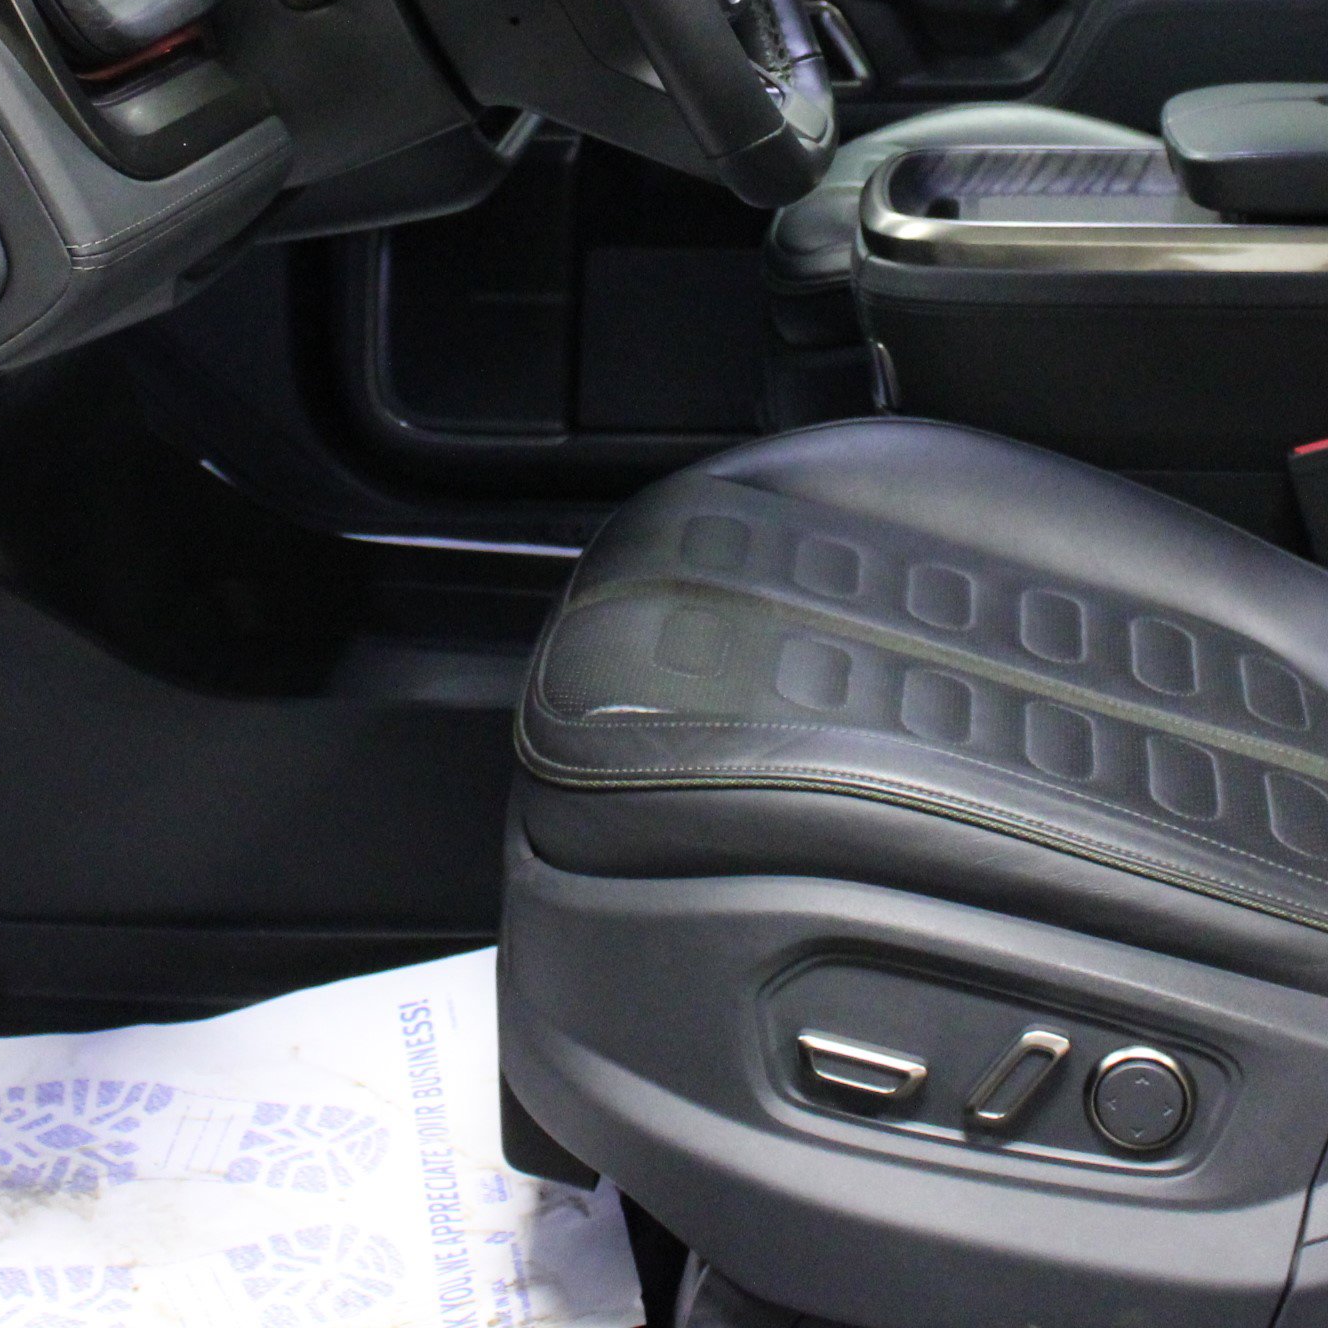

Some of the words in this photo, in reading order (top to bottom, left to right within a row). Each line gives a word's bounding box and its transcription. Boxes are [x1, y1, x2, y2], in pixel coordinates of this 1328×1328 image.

[398, 998, 443, 1099] BUSINESS!
[415, 1104, 450, 1146] YOUR
[421, 1148, 466, 1245] APPRECIATE
